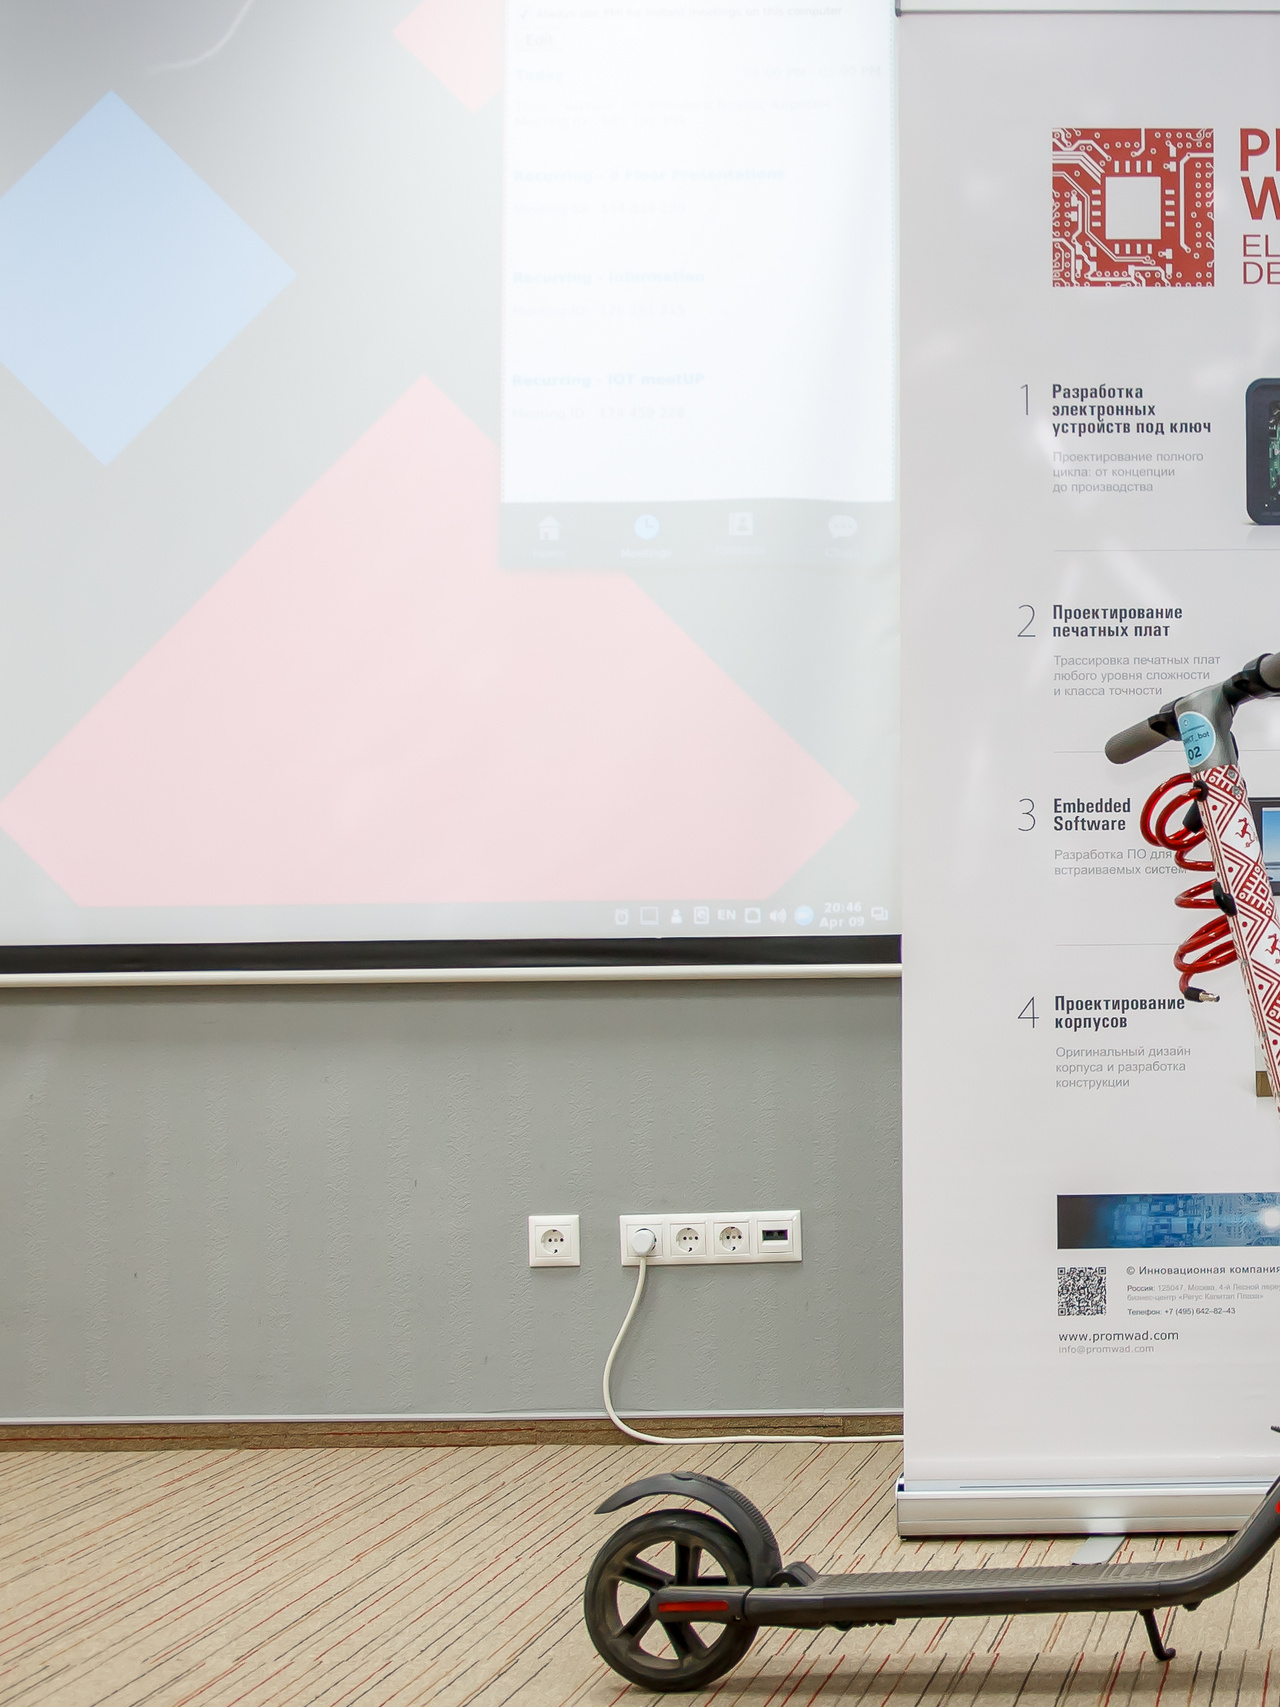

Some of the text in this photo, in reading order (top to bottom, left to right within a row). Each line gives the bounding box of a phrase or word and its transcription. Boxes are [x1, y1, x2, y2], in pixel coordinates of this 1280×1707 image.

[1020, 384, 1030, 416] 1
[1052, 384, 1144, 402] Разработка
[1052, 404, 1156, 421] электронных
[1052, 418, 1212, 438] устройств под ключ
[1053, 452, 1204, 464] Проектирование полного
[1053, 468, 1176, 479] цикла: от концепции
[1052, 483, 1154, 494] до производства
[1053, 604, 1183, 623] Проектирование
[1017, 604, 1036, 638] 2
[1053, 625, 1171, 638] печатных плат
[1053, 655, 1221, 668] Трассировка печатных плат
[1053, 670, 1211, 684] любого уровня сложности
[1053, 686, 1163, 697] и класса точности
[1187, 746, 1203, 760] 02
[1053, 798, 1131, 814] Embedded
[1018, 798, 1036, 832] 3
[1053, 816, 1127, 832] Software
[1054, 849, 1173, 862] Разработка ПО для
[1054, 865, 1142, 878] встраиваемых
[717, 909, 737, 922] EN
[818, 916, 844, 930] Apr
[1054, 995, 1186, 1014] Проектирование
[1018, 996, 1040, 1029] 4
[1054, 1016, 1128, 1032] корпусов
[1055, 1046, 1191, 1059] Оригинальный дизайн
[1055, 1061, 1186, 1075] корпуса и разработка
[1055, 1078, 1130, 1090] конструкции
[1138, 1265, 1226, 1276] Инновационная
[1058, 1330, 1180, 1344] www.promwad.com
[1058, 1344, 1155, 1356] info@promwad.com
